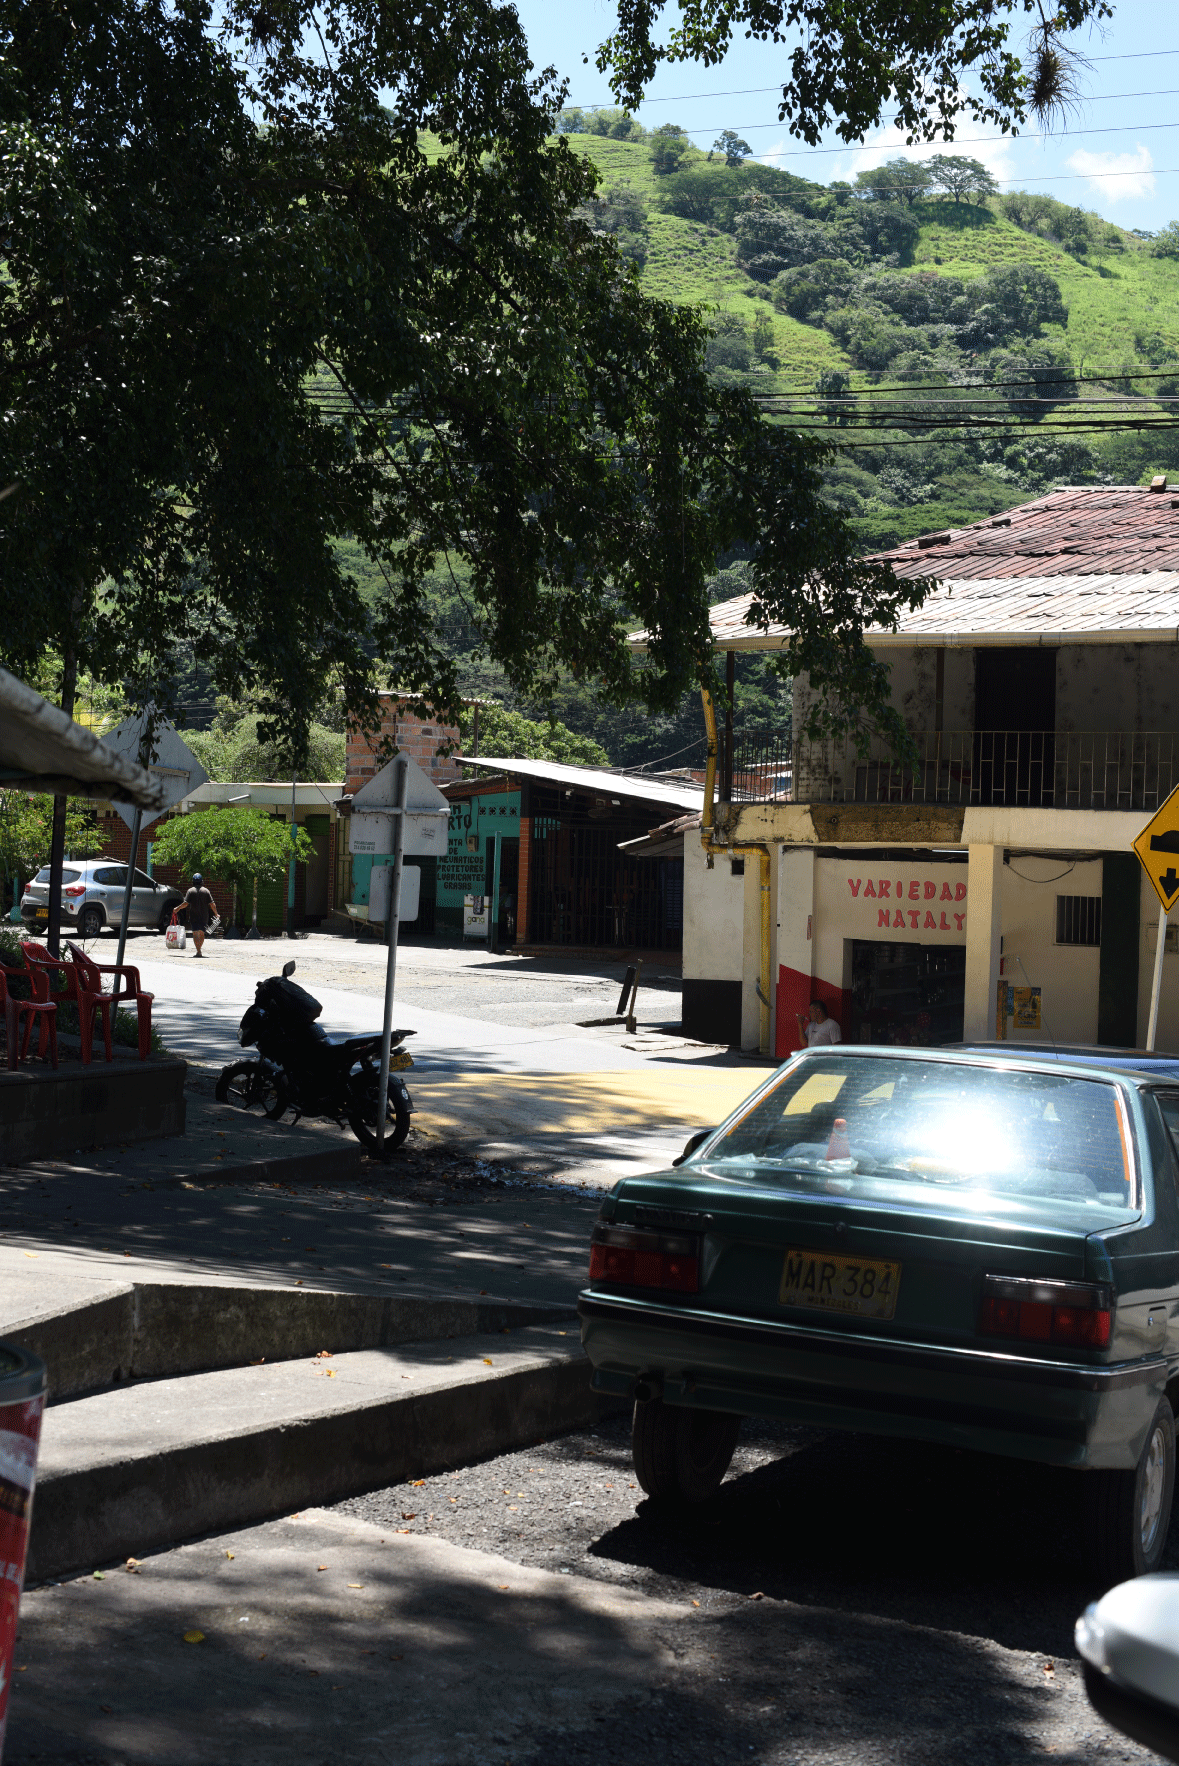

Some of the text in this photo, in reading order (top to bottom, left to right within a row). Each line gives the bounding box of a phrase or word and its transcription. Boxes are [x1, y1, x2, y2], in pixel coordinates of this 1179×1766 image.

[448, 847, 459, 855] DE
[437, 873, 486, 882] LUBRICANTES
[443, 881, 472, 890] GRASAS
[877, 908, 966, 931] NATALY
[785, 1259, 892, 1299] MAR 384
